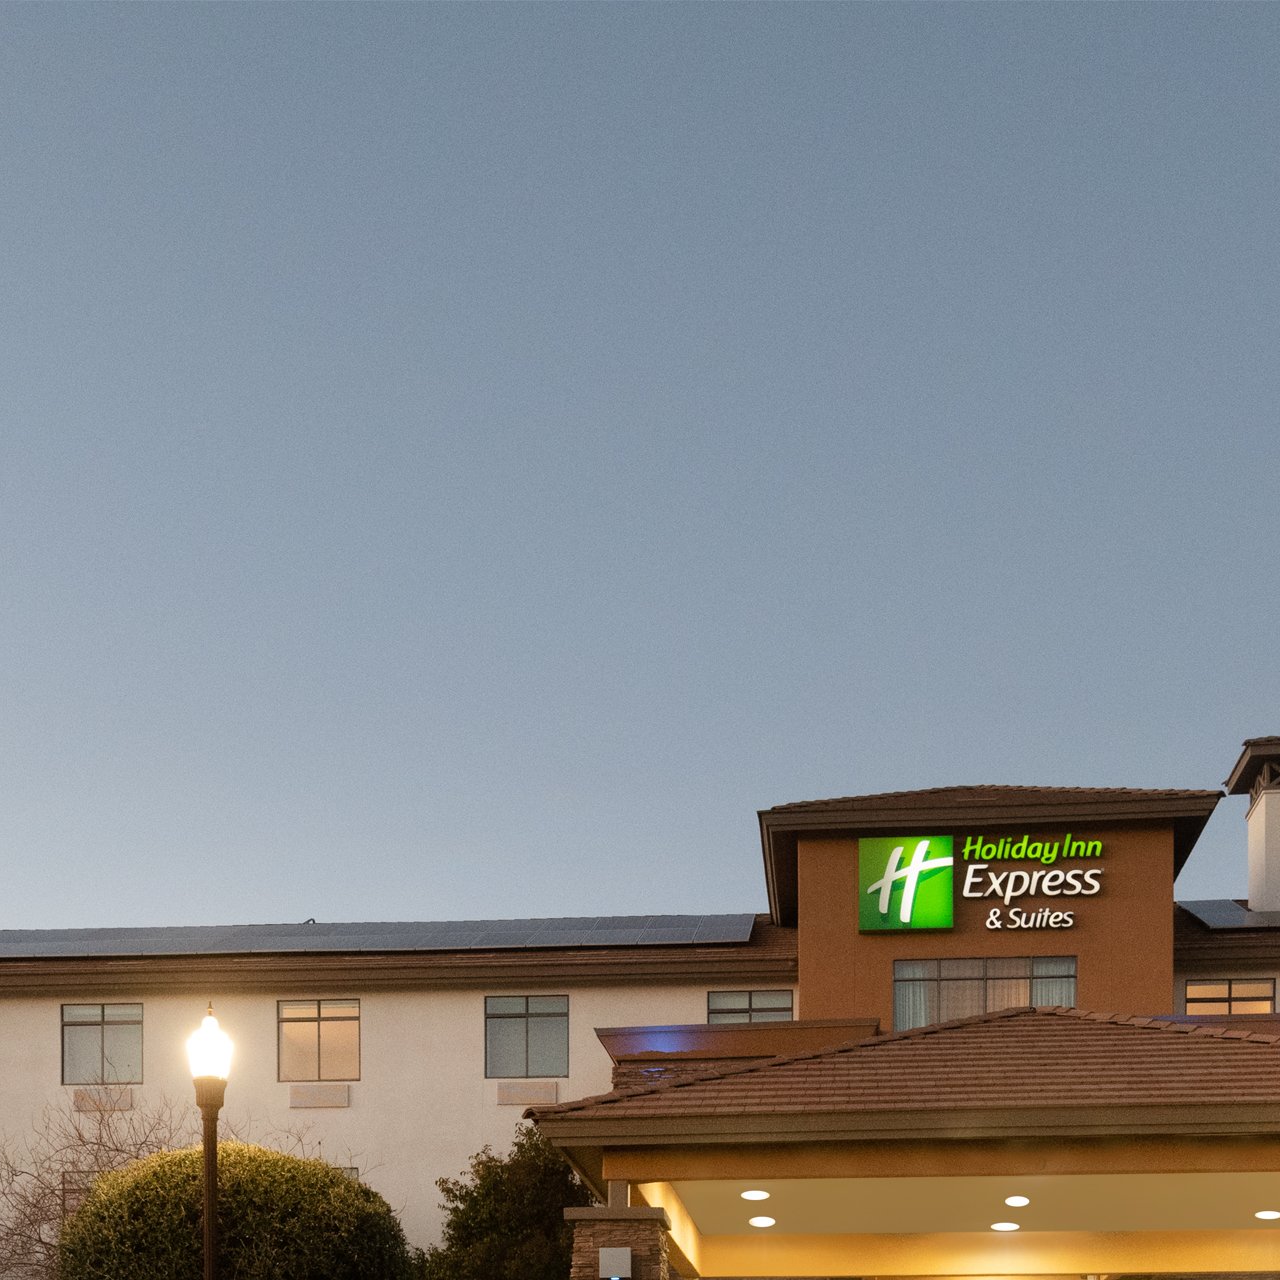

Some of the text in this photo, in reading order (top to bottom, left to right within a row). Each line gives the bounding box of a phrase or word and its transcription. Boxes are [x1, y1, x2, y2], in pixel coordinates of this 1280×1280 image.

[962, 833, 1103, 864] Holiday Inn
[867, 840, 954, 923] H
[962, 864, 1102, 906] Express
[985, 907, 1074, 930] & Suites
